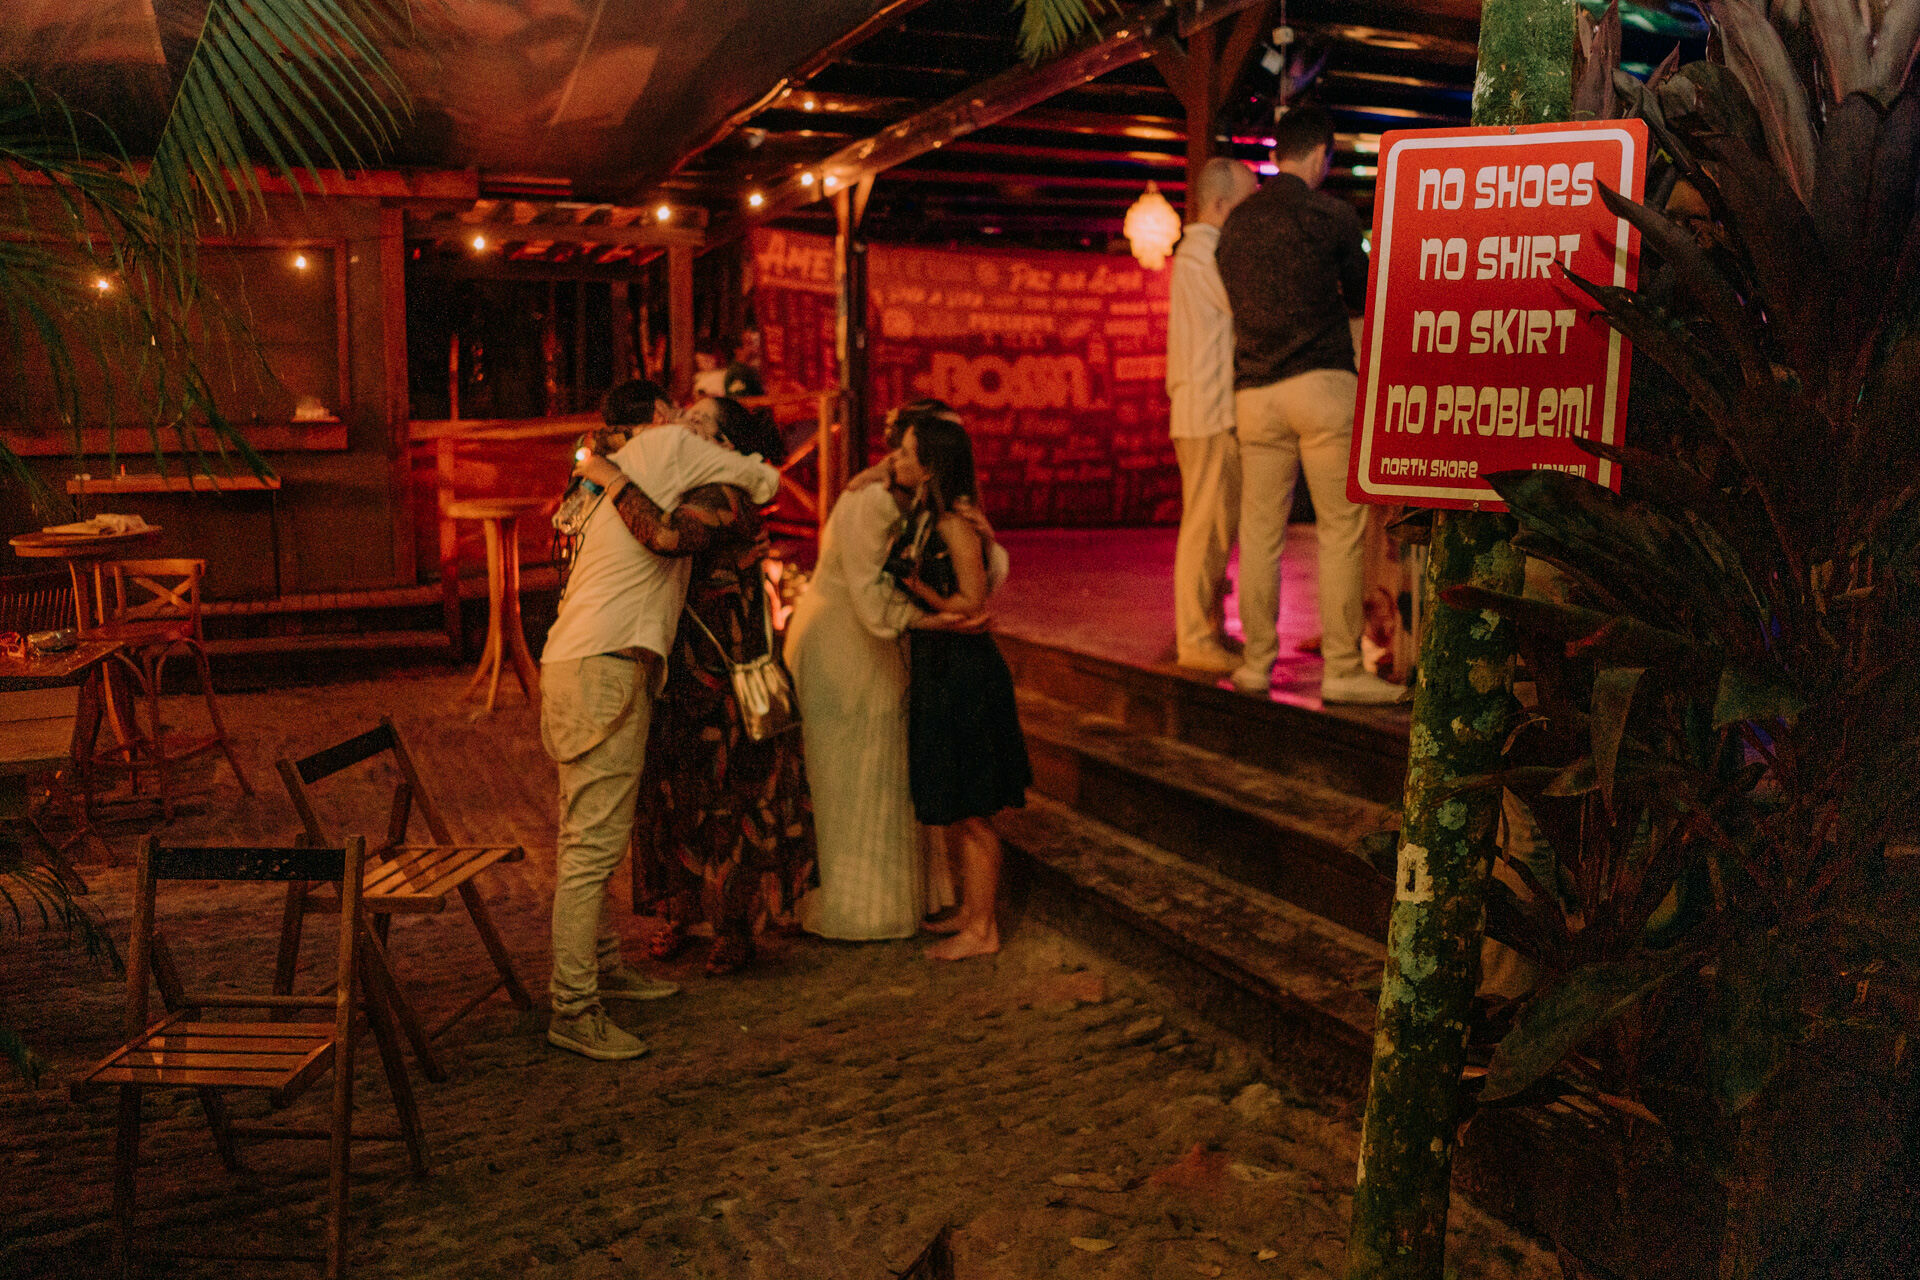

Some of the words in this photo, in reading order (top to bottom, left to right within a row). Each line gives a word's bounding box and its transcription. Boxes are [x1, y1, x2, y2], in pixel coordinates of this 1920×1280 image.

[1476, 233, 1581, 281] SHIRT
[1469, 308, 1577, 355] SKIRT
[1380, 457, 1428, 477] NORTH
